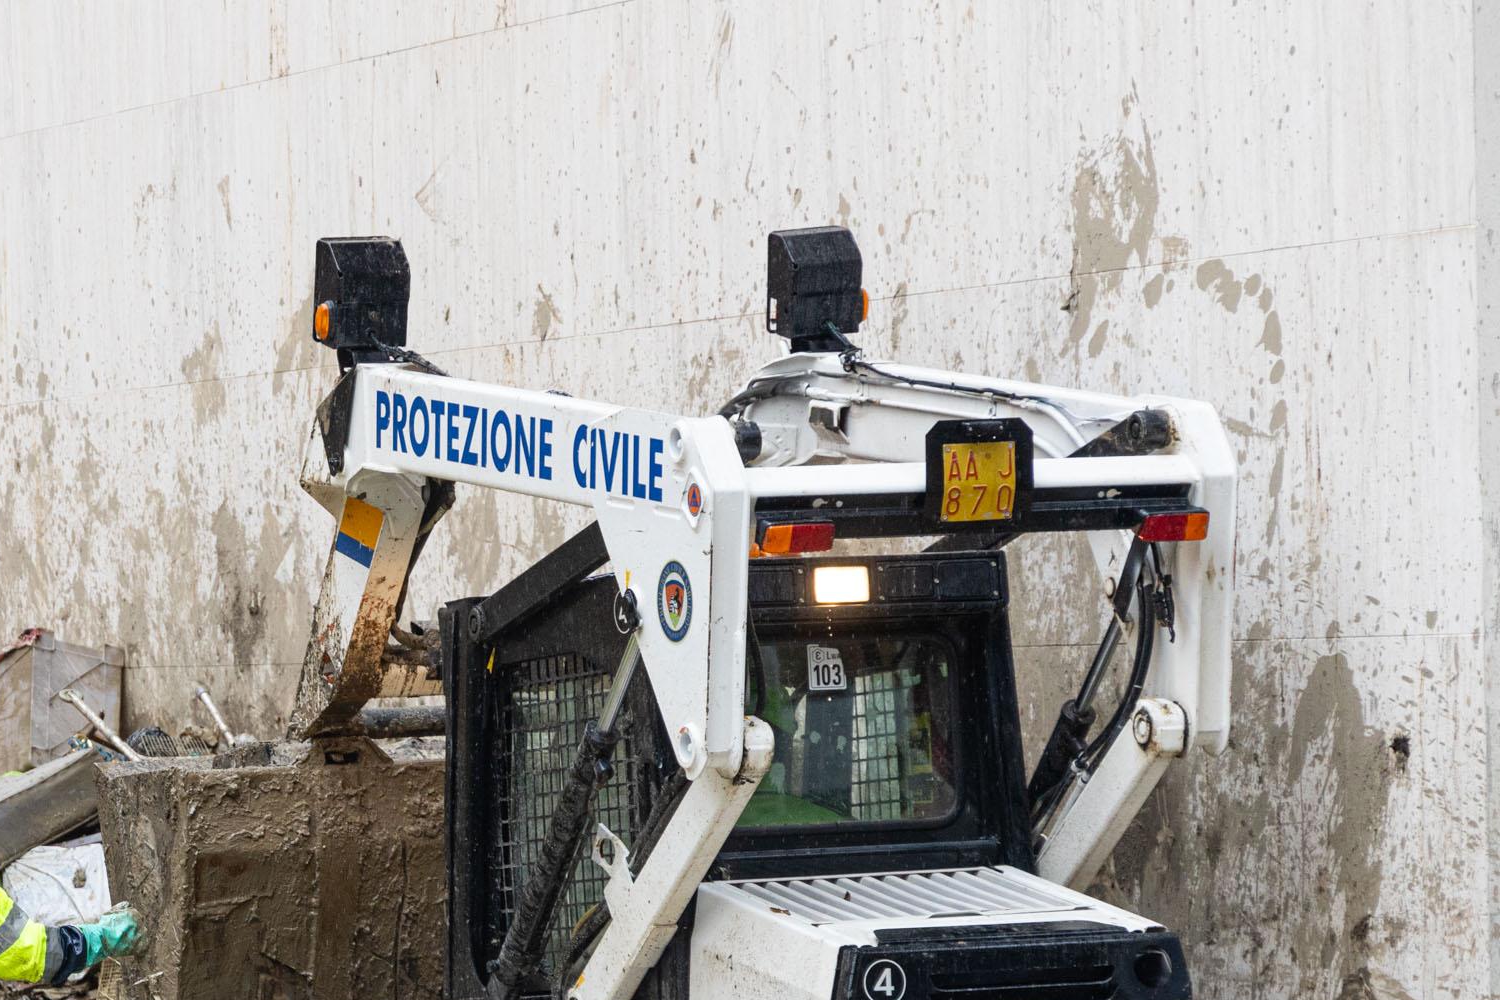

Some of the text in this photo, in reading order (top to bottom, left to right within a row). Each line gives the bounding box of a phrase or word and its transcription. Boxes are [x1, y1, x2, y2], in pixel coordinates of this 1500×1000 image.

[376, 390, 664, 502] PROTEZIONE CIVILE
[948, 446, 1012, 481] AA J
[946, 484, 1012, 515] 870
[813, 664, 842, 686] 103
[873, 967, 895, 997] 4
